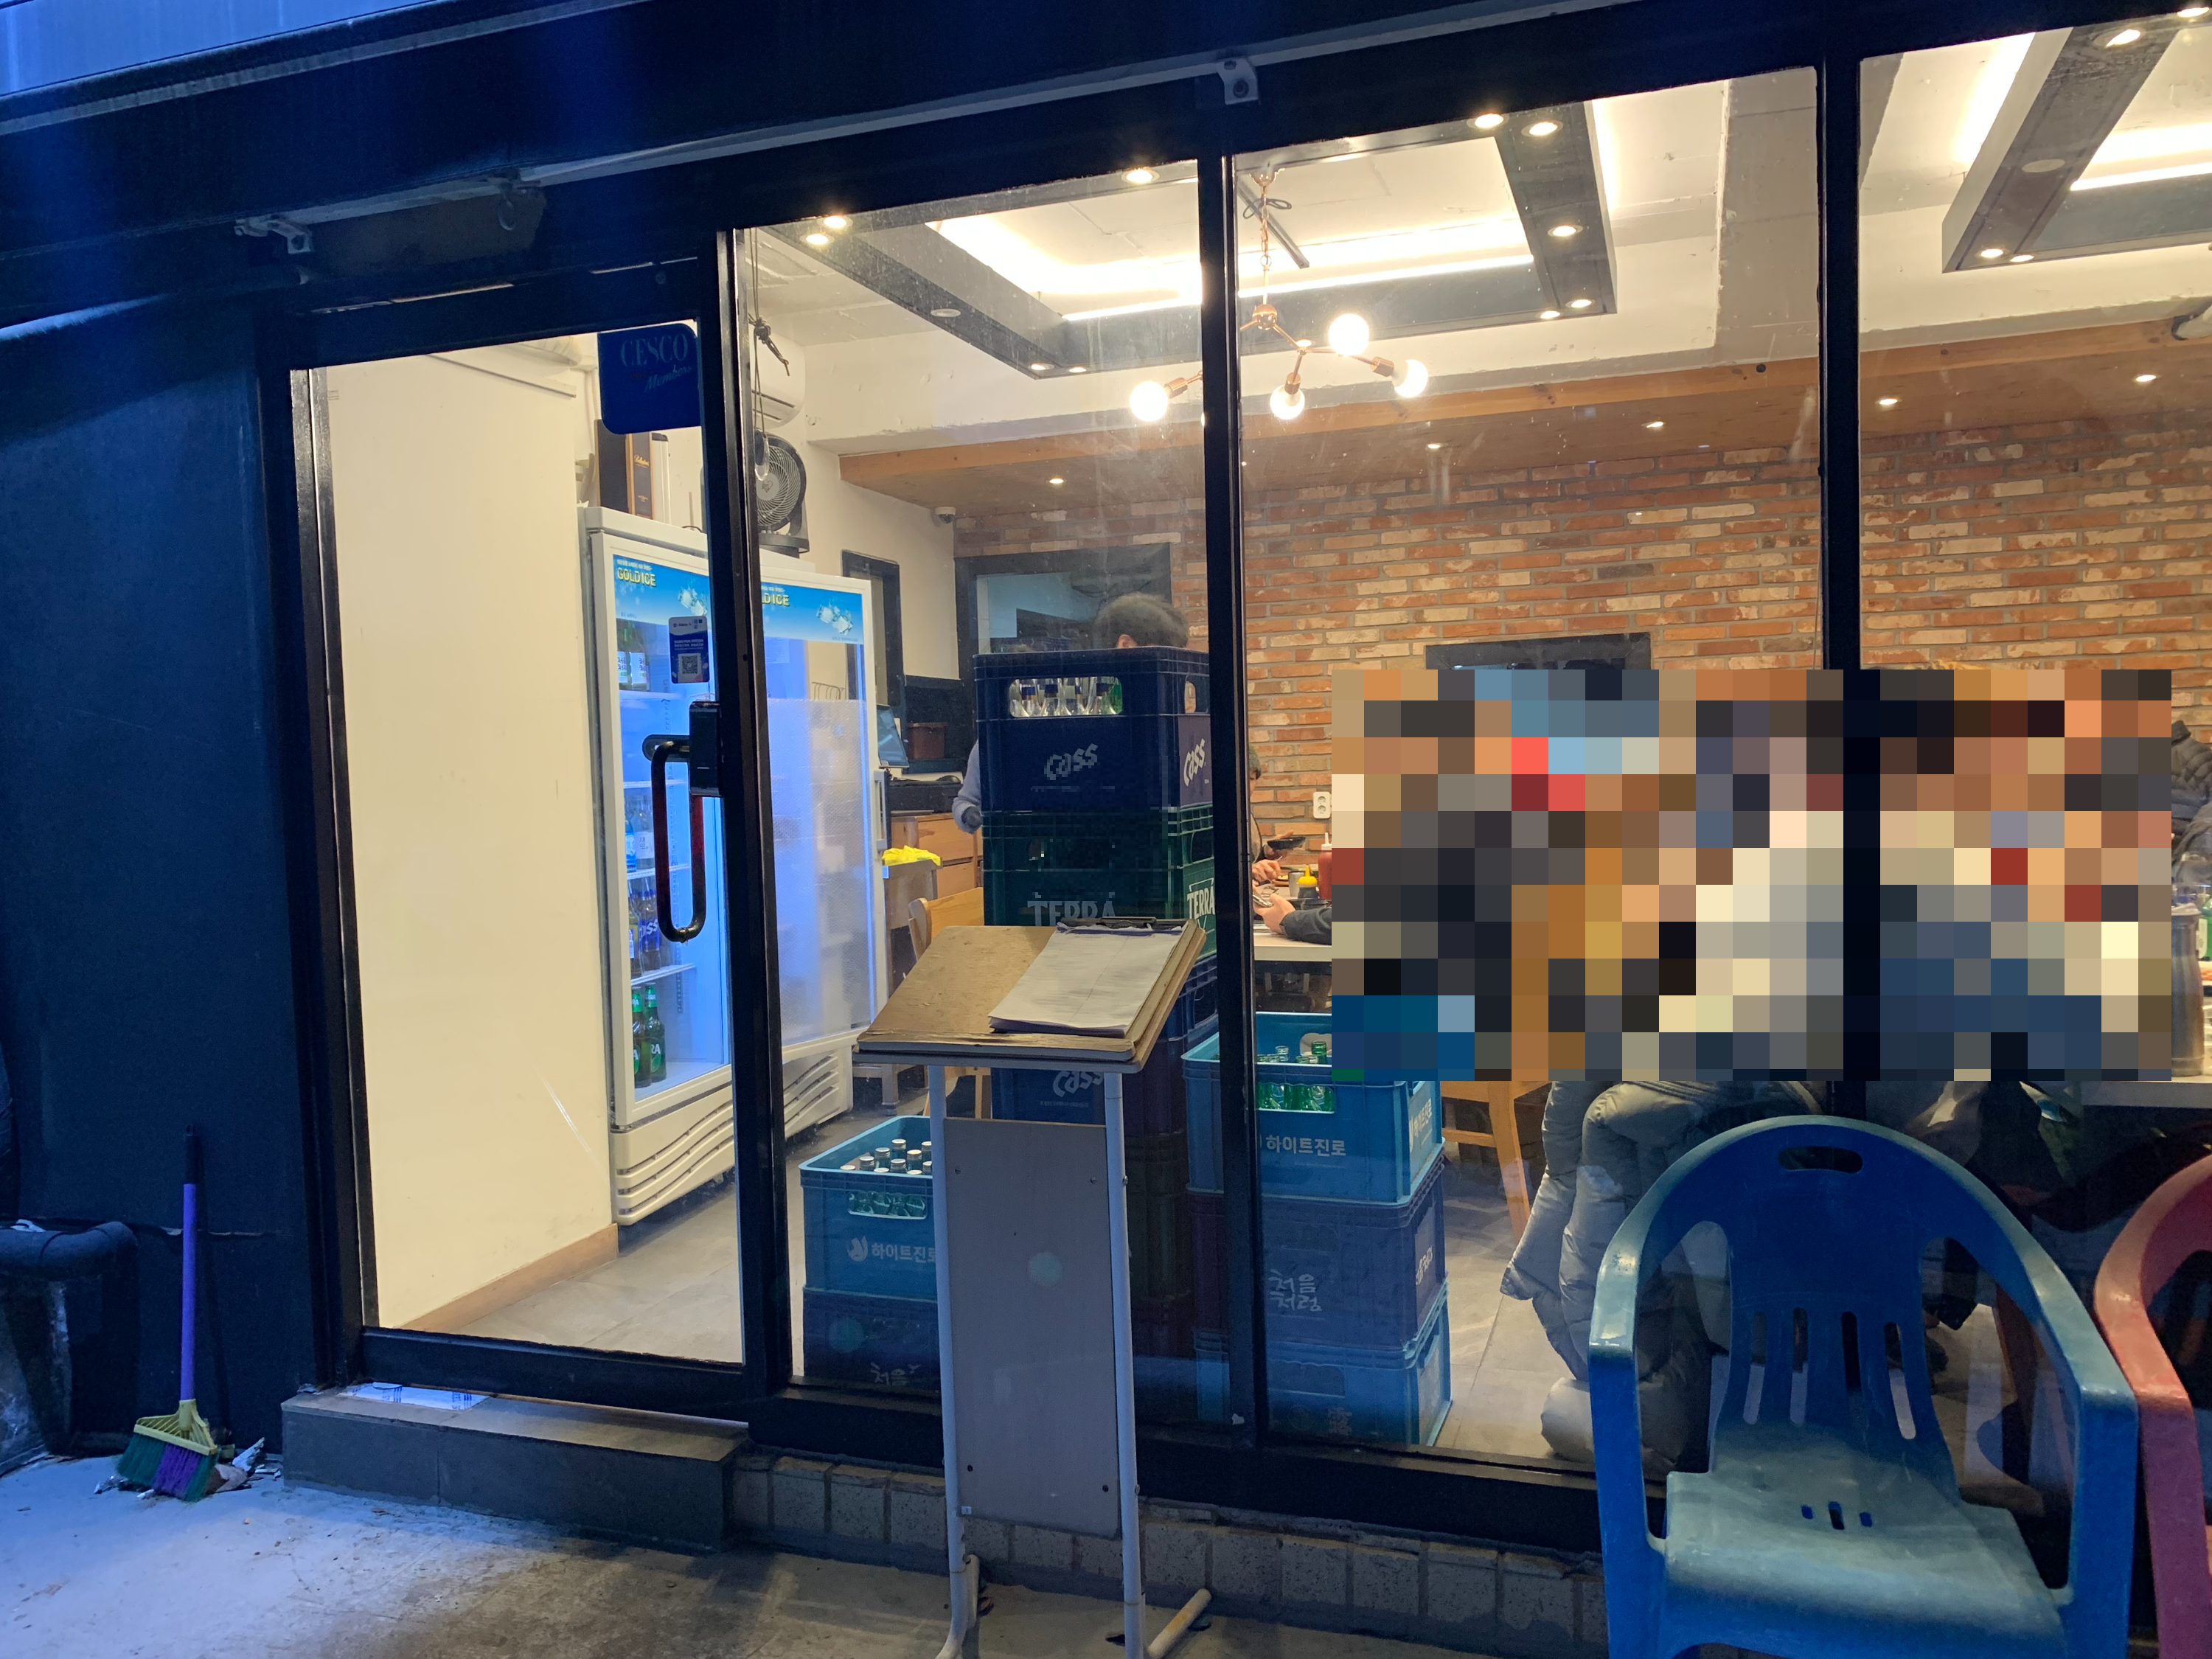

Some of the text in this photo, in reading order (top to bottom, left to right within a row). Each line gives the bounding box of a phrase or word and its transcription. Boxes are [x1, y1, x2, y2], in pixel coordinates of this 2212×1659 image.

[620, 334, 689, 367] CESCO
[644, 364, 692, 392] Members
[1186, 886, 1216, 920] TERRA
[1266, 1135, 1346, 1157] 하이트진로
[1268, 1268, 1316, 1293] 처음
[1269, 1291, 1323, 1312] 처럼
